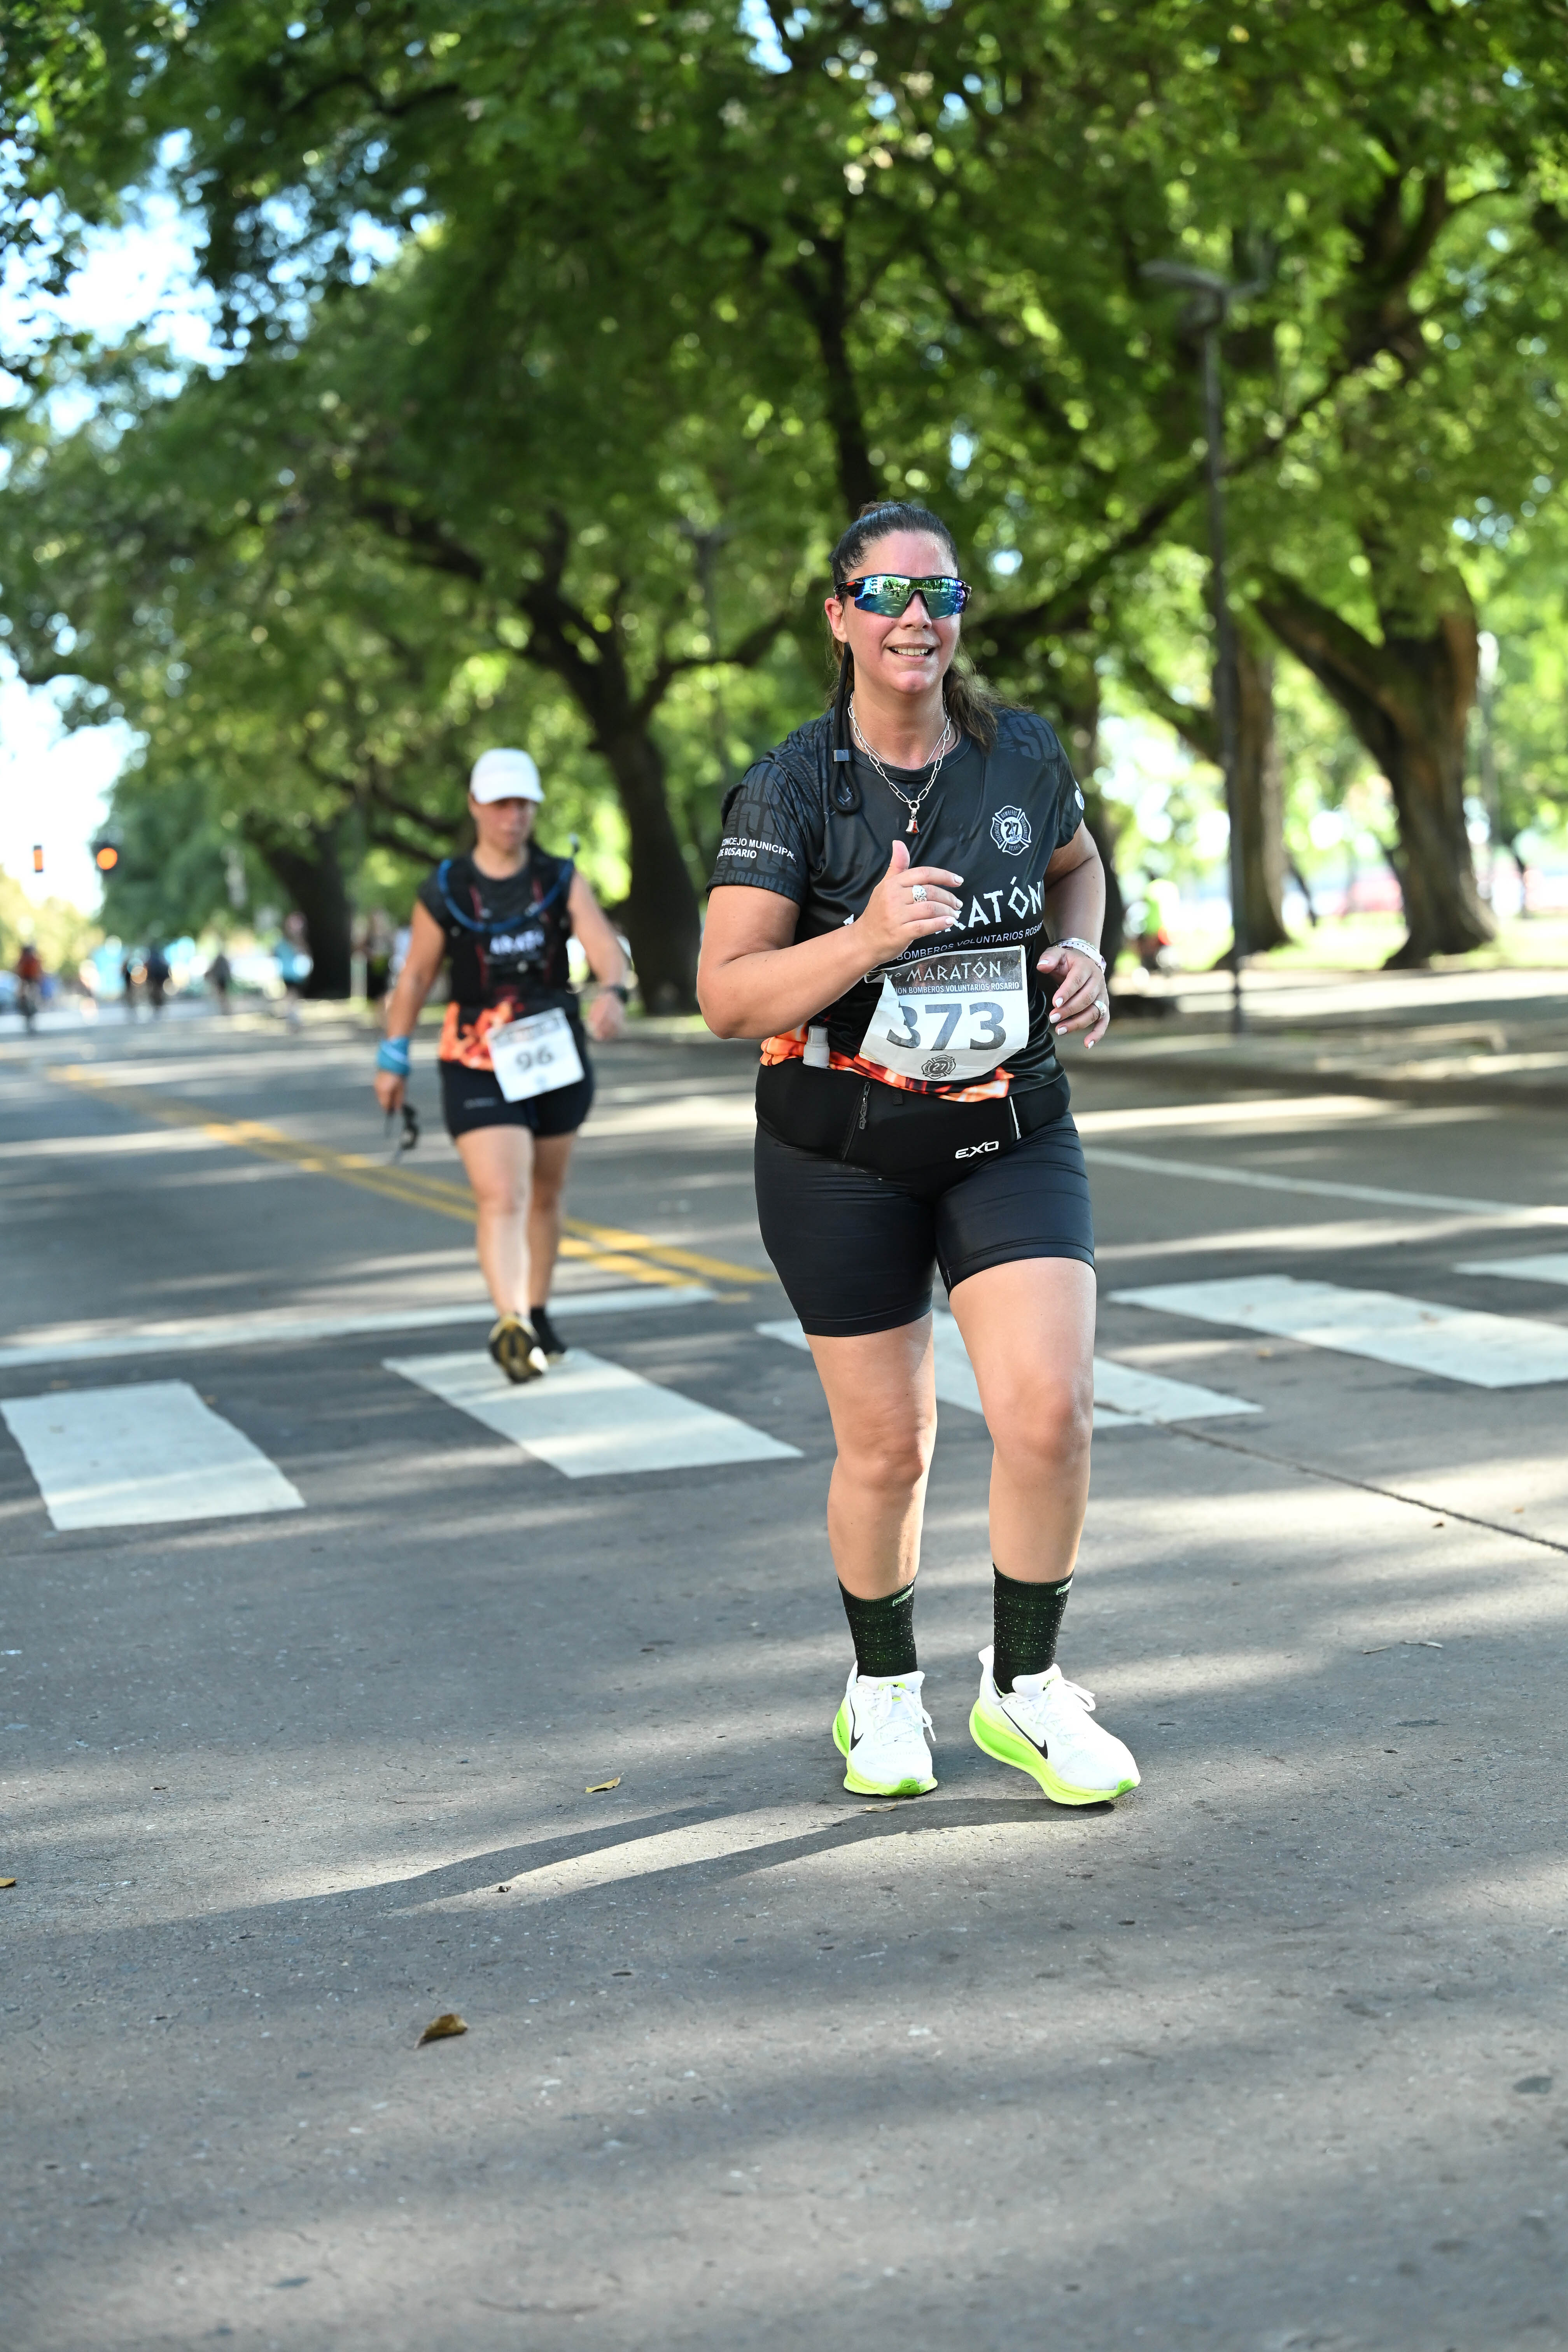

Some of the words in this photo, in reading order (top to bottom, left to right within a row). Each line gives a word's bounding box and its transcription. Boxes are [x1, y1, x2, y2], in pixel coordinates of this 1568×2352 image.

[1004, 822, 1018, 838] 27
[722, 837, 747, 847] CONCEJO
[719, 848, 724, 857] DE
[724, 847, 757, 859] ROSARIO
[897, 943, 954, 961] BOMBEROS
[957, 931, 1024, 947] VOLUNTARIOS
[906, 957, 1001, 982] MARATÓN
[946, 984, 989, 992] VOLUNTARIOS
[991, 982, 1019, 990] ROSARIO
[886, 1002, 1006, 1051] 373
[516, 1045, 554, 1072] 96
[932, 1063, 947, 1071] 27
[955, 1141, 999, 1159] EXO
